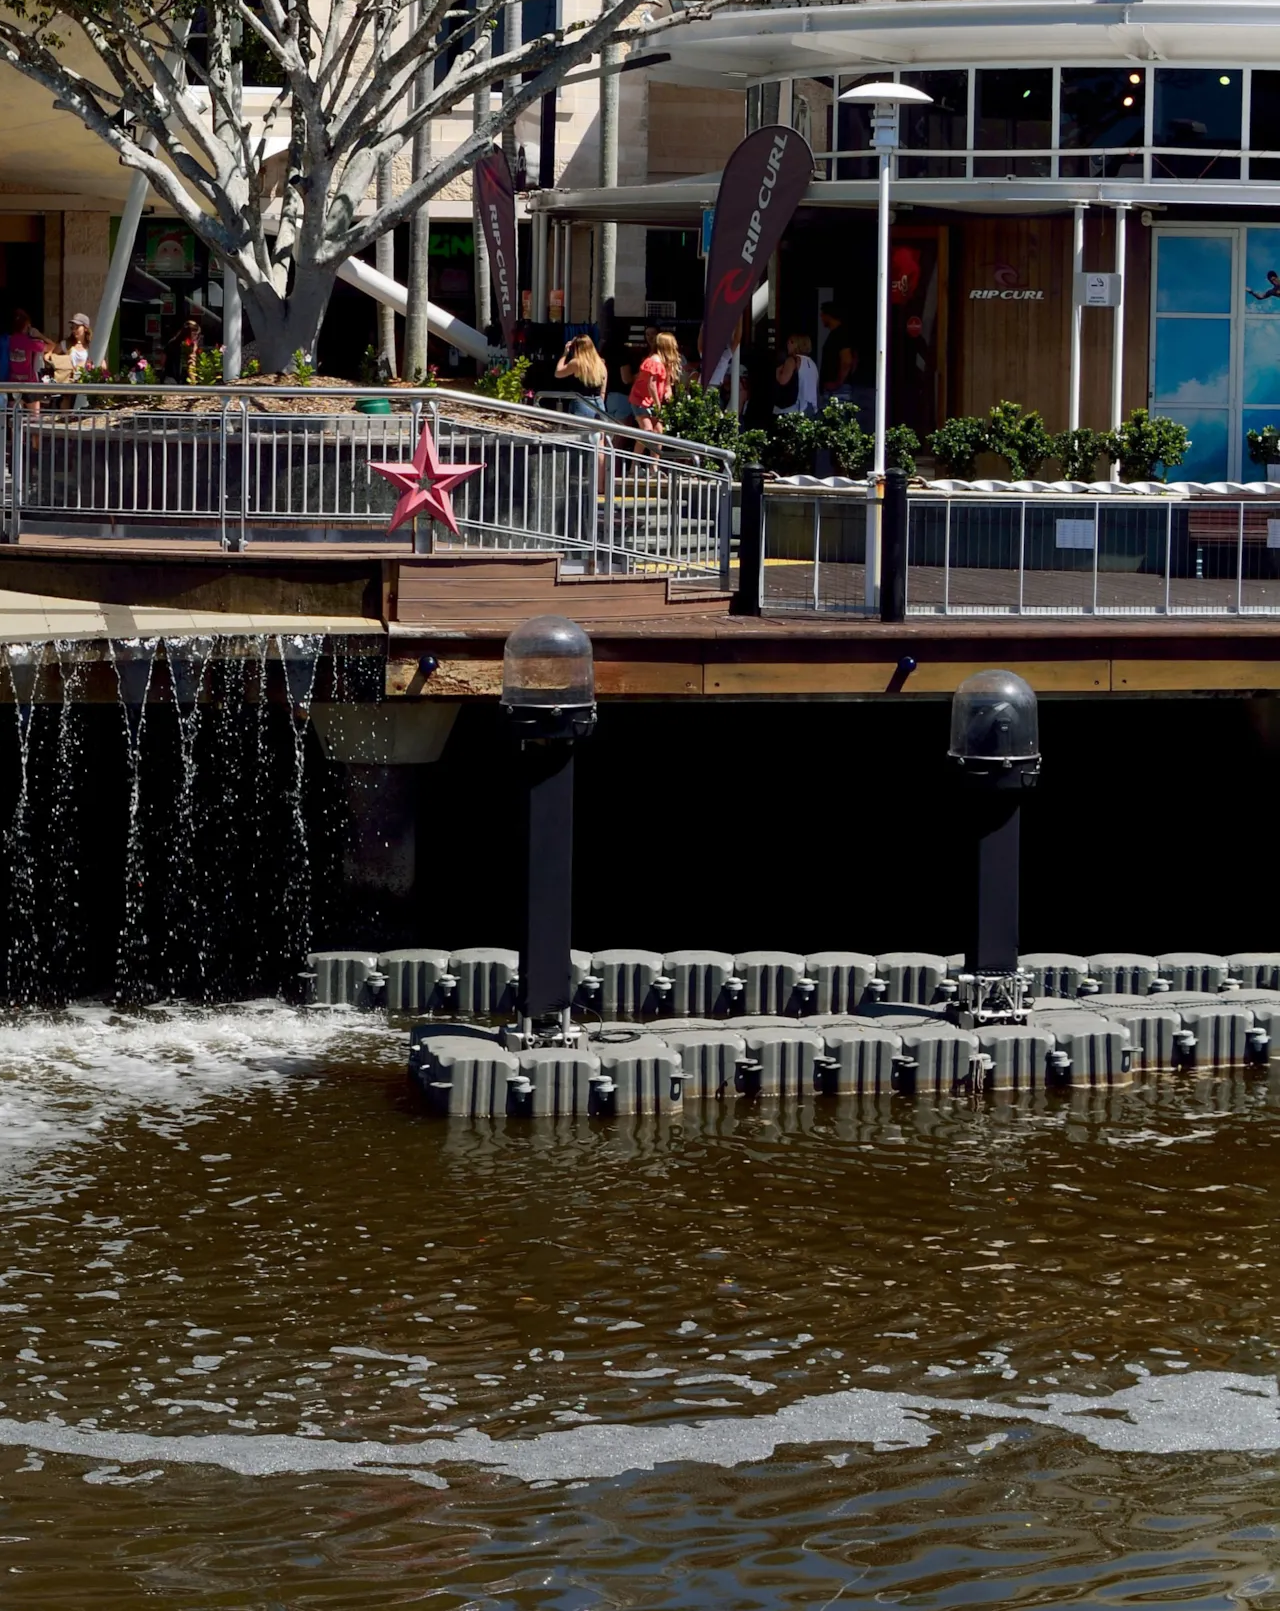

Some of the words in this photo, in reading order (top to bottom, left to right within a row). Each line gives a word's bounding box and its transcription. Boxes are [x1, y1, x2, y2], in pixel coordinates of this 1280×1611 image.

[741, 210, 762, 265] RIP
[758, 134, 788, 209] CURL
[489, 204, 501, 248] RIP
[495, 250, 512, 317] CURL
[969, 290, 1000, 299] RIP
[1000, 290, 1044, 300] CURL
